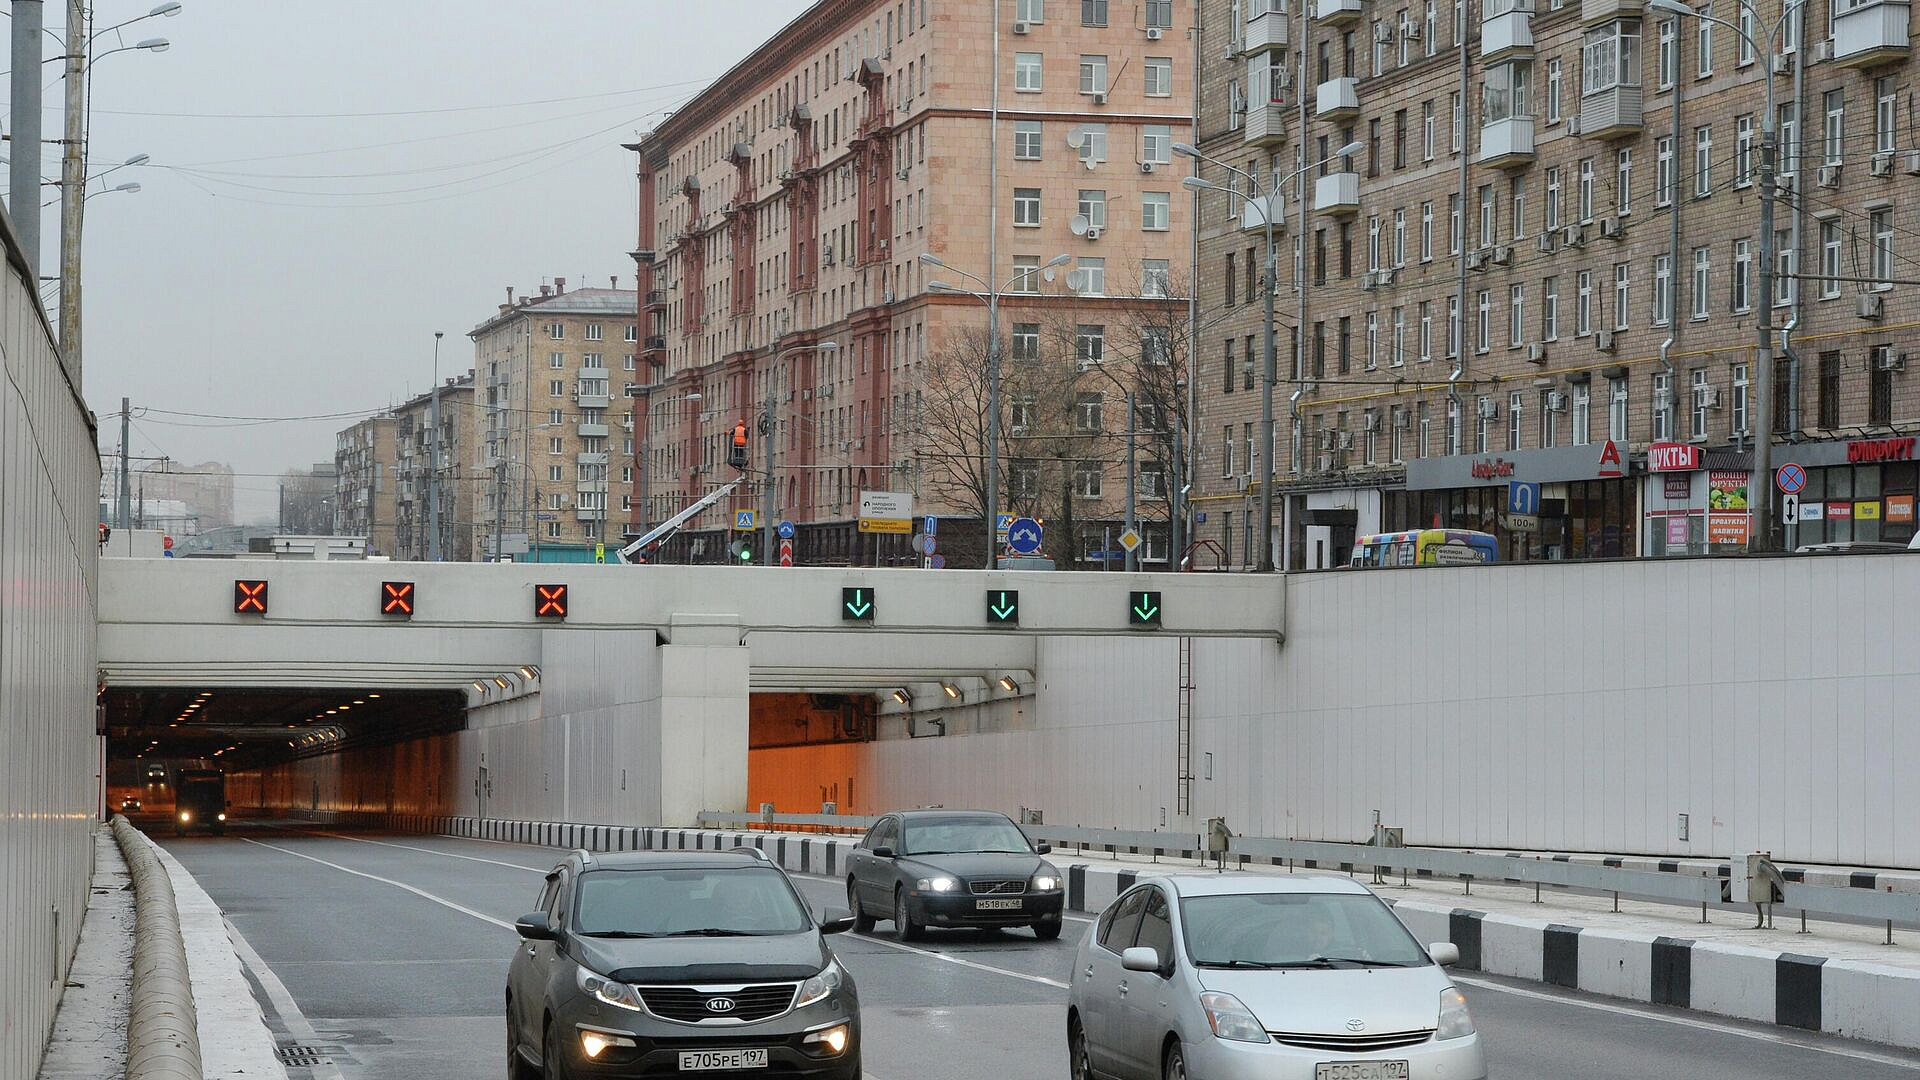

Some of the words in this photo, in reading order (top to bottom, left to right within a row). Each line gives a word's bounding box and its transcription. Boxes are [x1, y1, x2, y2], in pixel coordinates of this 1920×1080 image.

[1710, 480, 1747, 488] ФРУКТЫ
[710, 1000, 731, 1009] KIA
[683, 1053, 740, 1068] Е705РЕ
[742, 1051, 764, 1062] 197
[1383, 1063, 1404, 1075] 197
